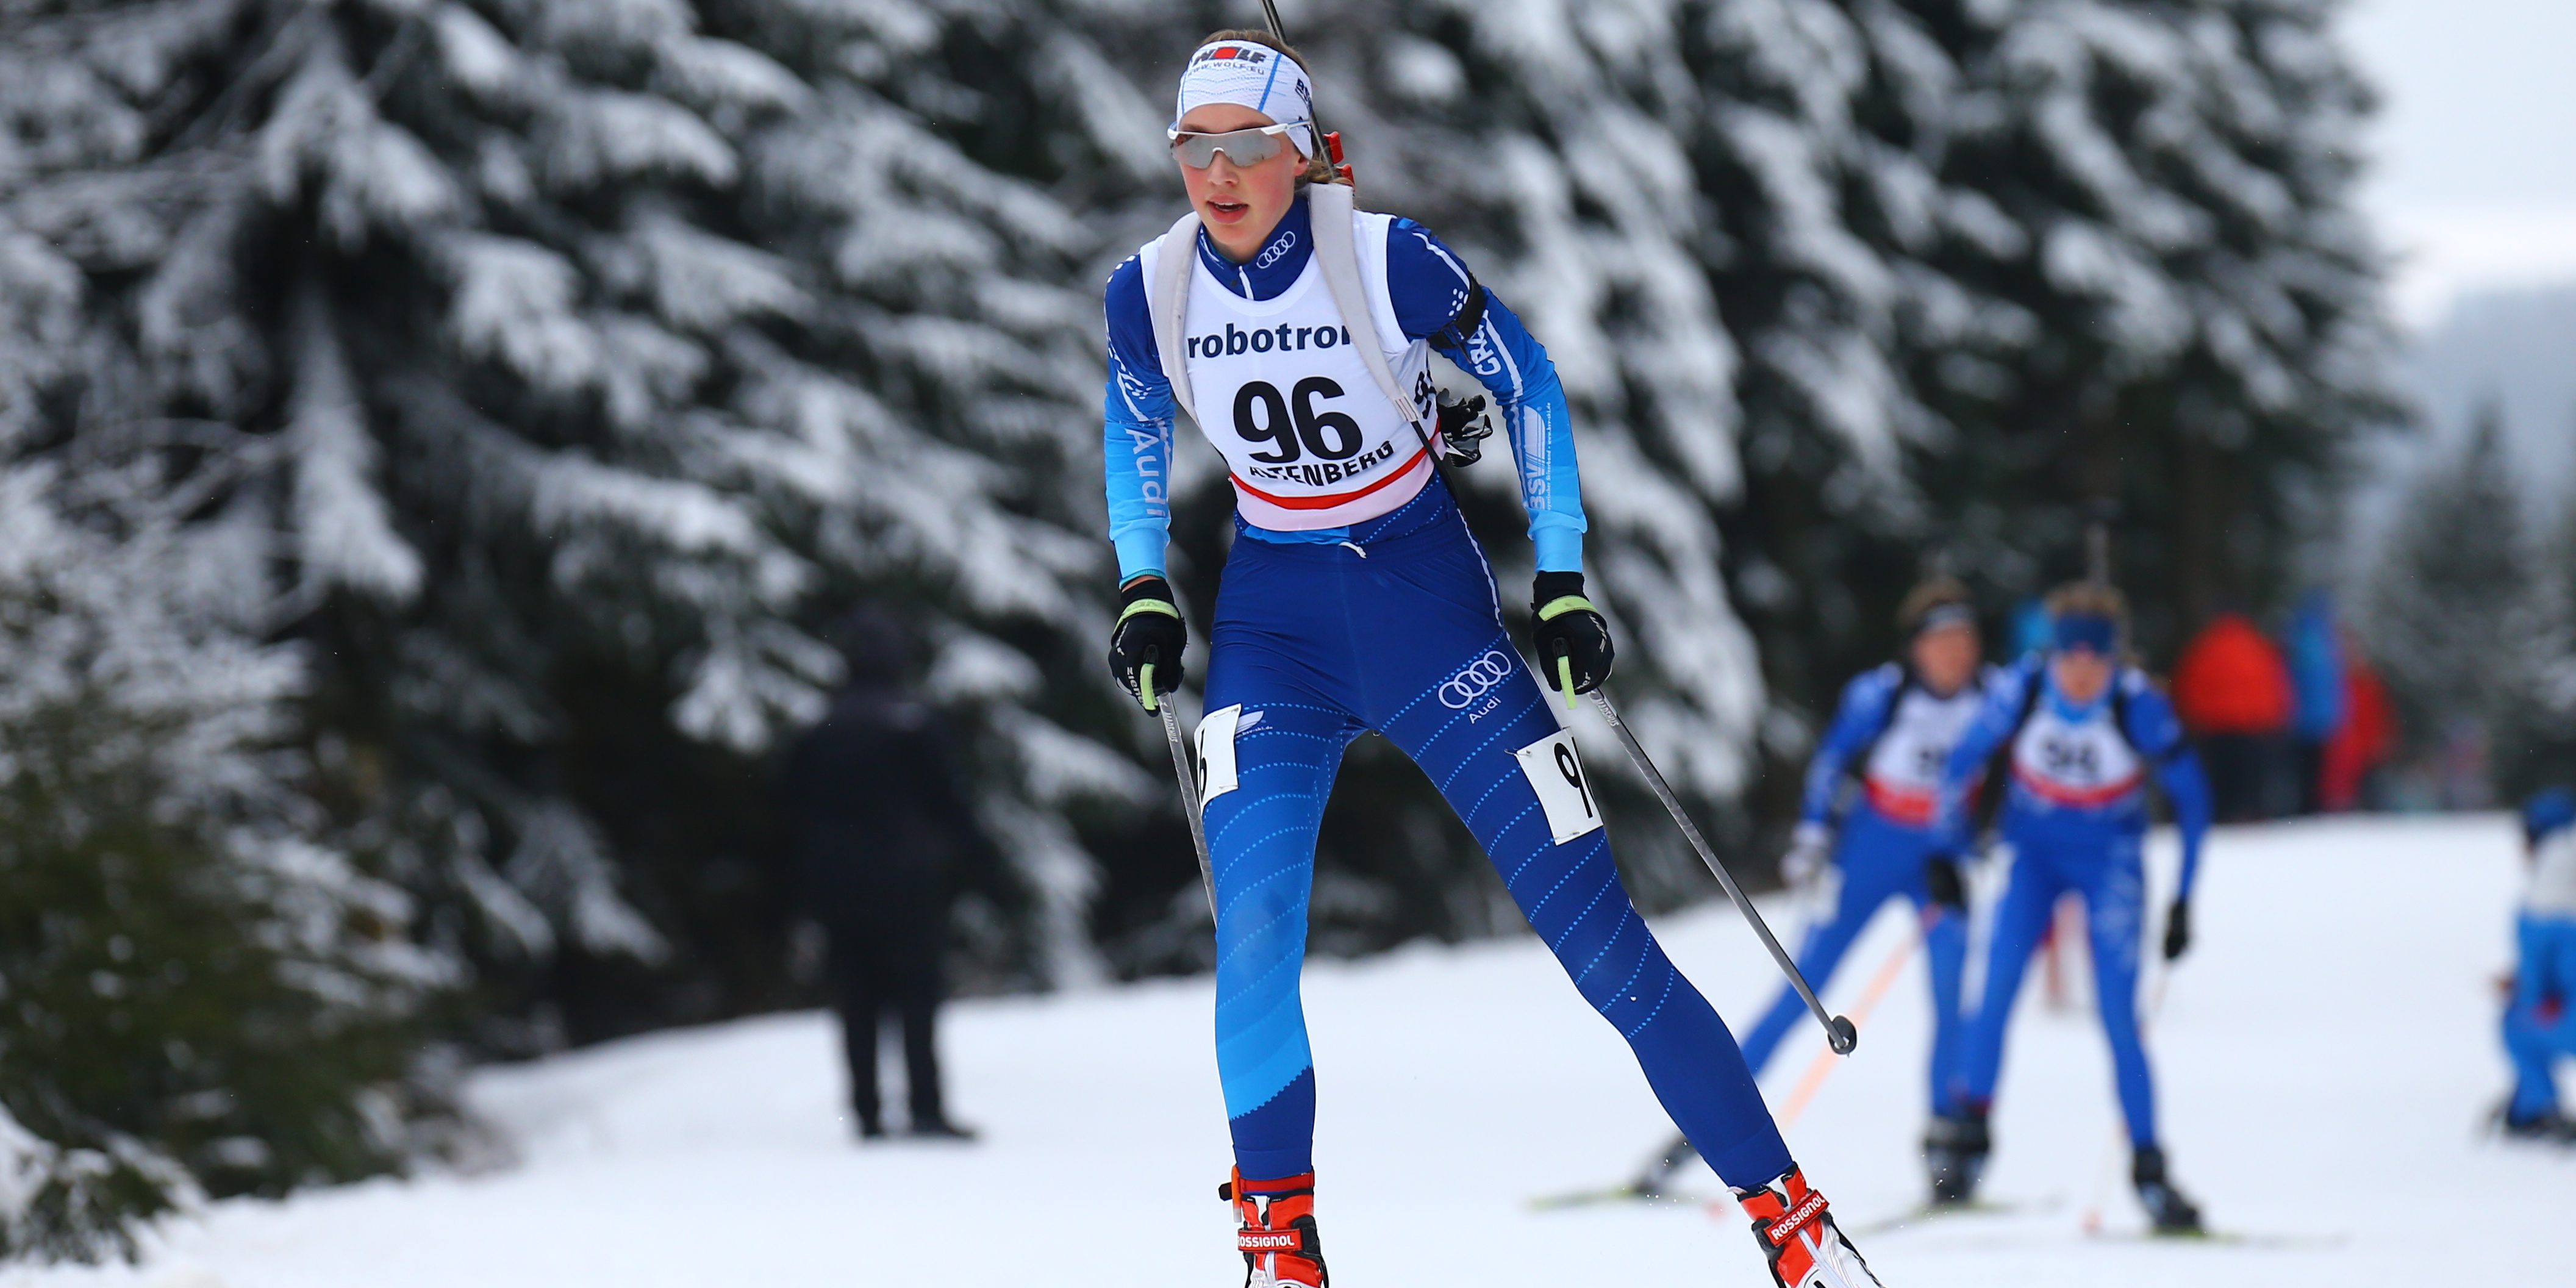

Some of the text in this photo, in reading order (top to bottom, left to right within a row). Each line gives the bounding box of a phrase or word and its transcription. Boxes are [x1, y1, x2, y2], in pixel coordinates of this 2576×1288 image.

[1467, 324, 1501, 375] CRA
[1233, 376, 1363, 463] 96
[1125, 428, 1166, 517] Audi
[1469, 696, 1501, 724] Audi
[1554, 737, 1594, 818] 9
[1770, 1194, 1826, 1240] ROSSIGNOL
